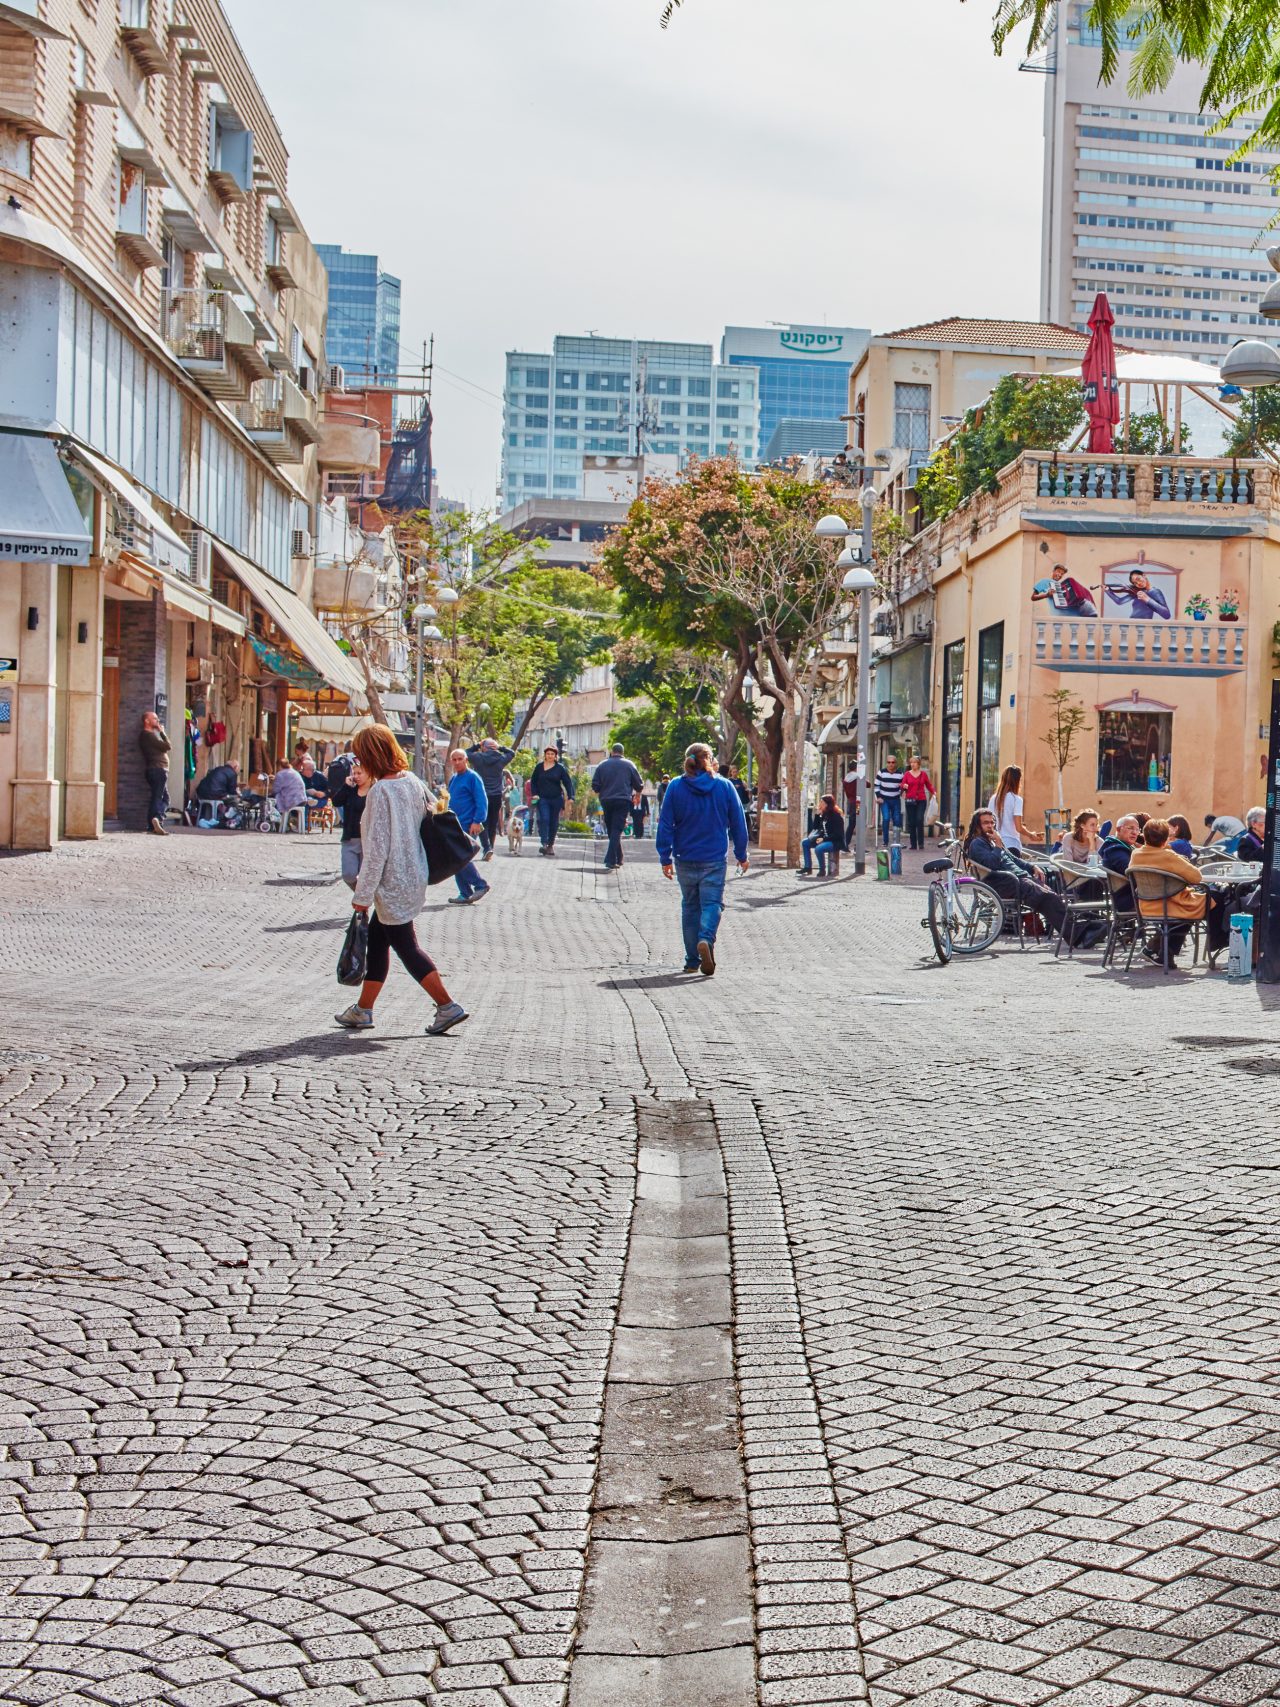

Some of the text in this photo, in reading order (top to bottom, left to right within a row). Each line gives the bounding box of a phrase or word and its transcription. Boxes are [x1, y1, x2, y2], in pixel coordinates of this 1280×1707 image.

[780, 332, 844, 347] דיסקונט
[14, 543, 48, 555] בינימין
[50, 545, 78, 557] נחלת
